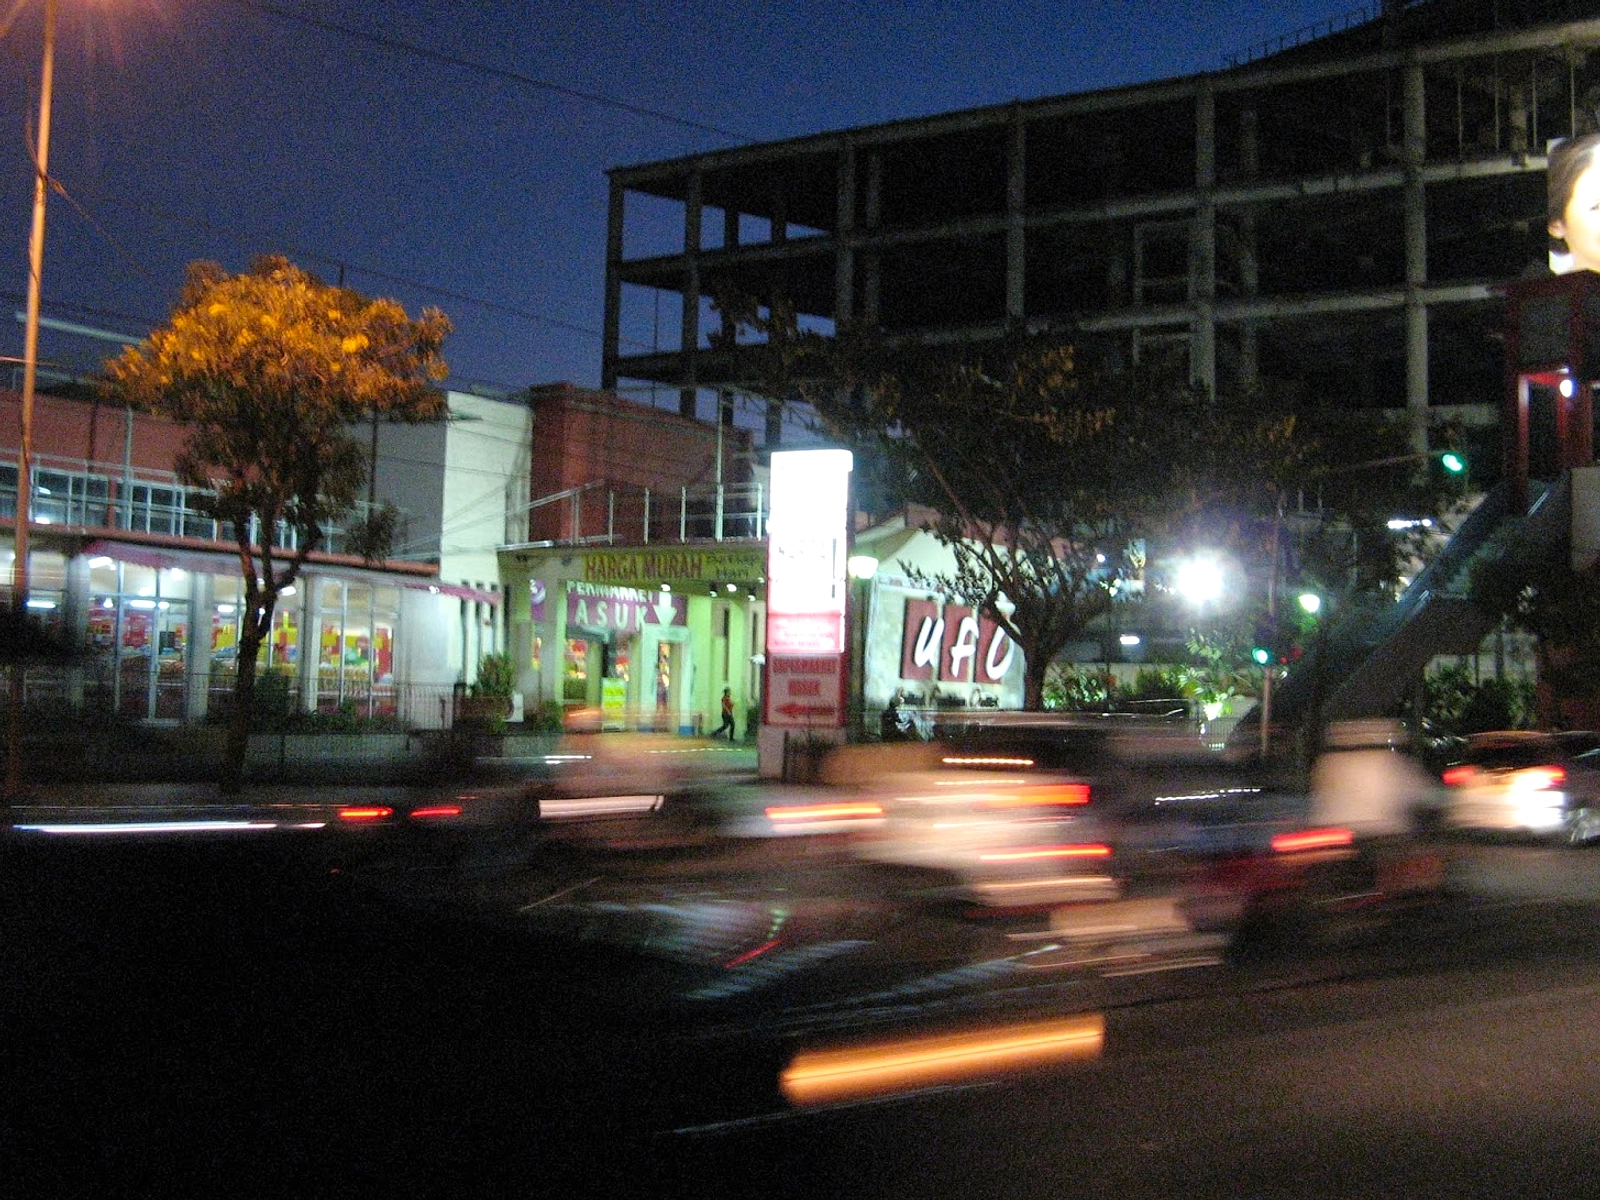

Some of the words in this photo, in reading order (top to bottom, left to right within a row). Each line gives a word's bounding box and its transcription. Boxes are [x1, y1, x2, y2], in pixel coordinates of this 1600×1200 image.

[585, 553, 638, 581] HARGA
[642, 553, 702, 580] MURAH
[914, 615, 1015, 680] UFO
